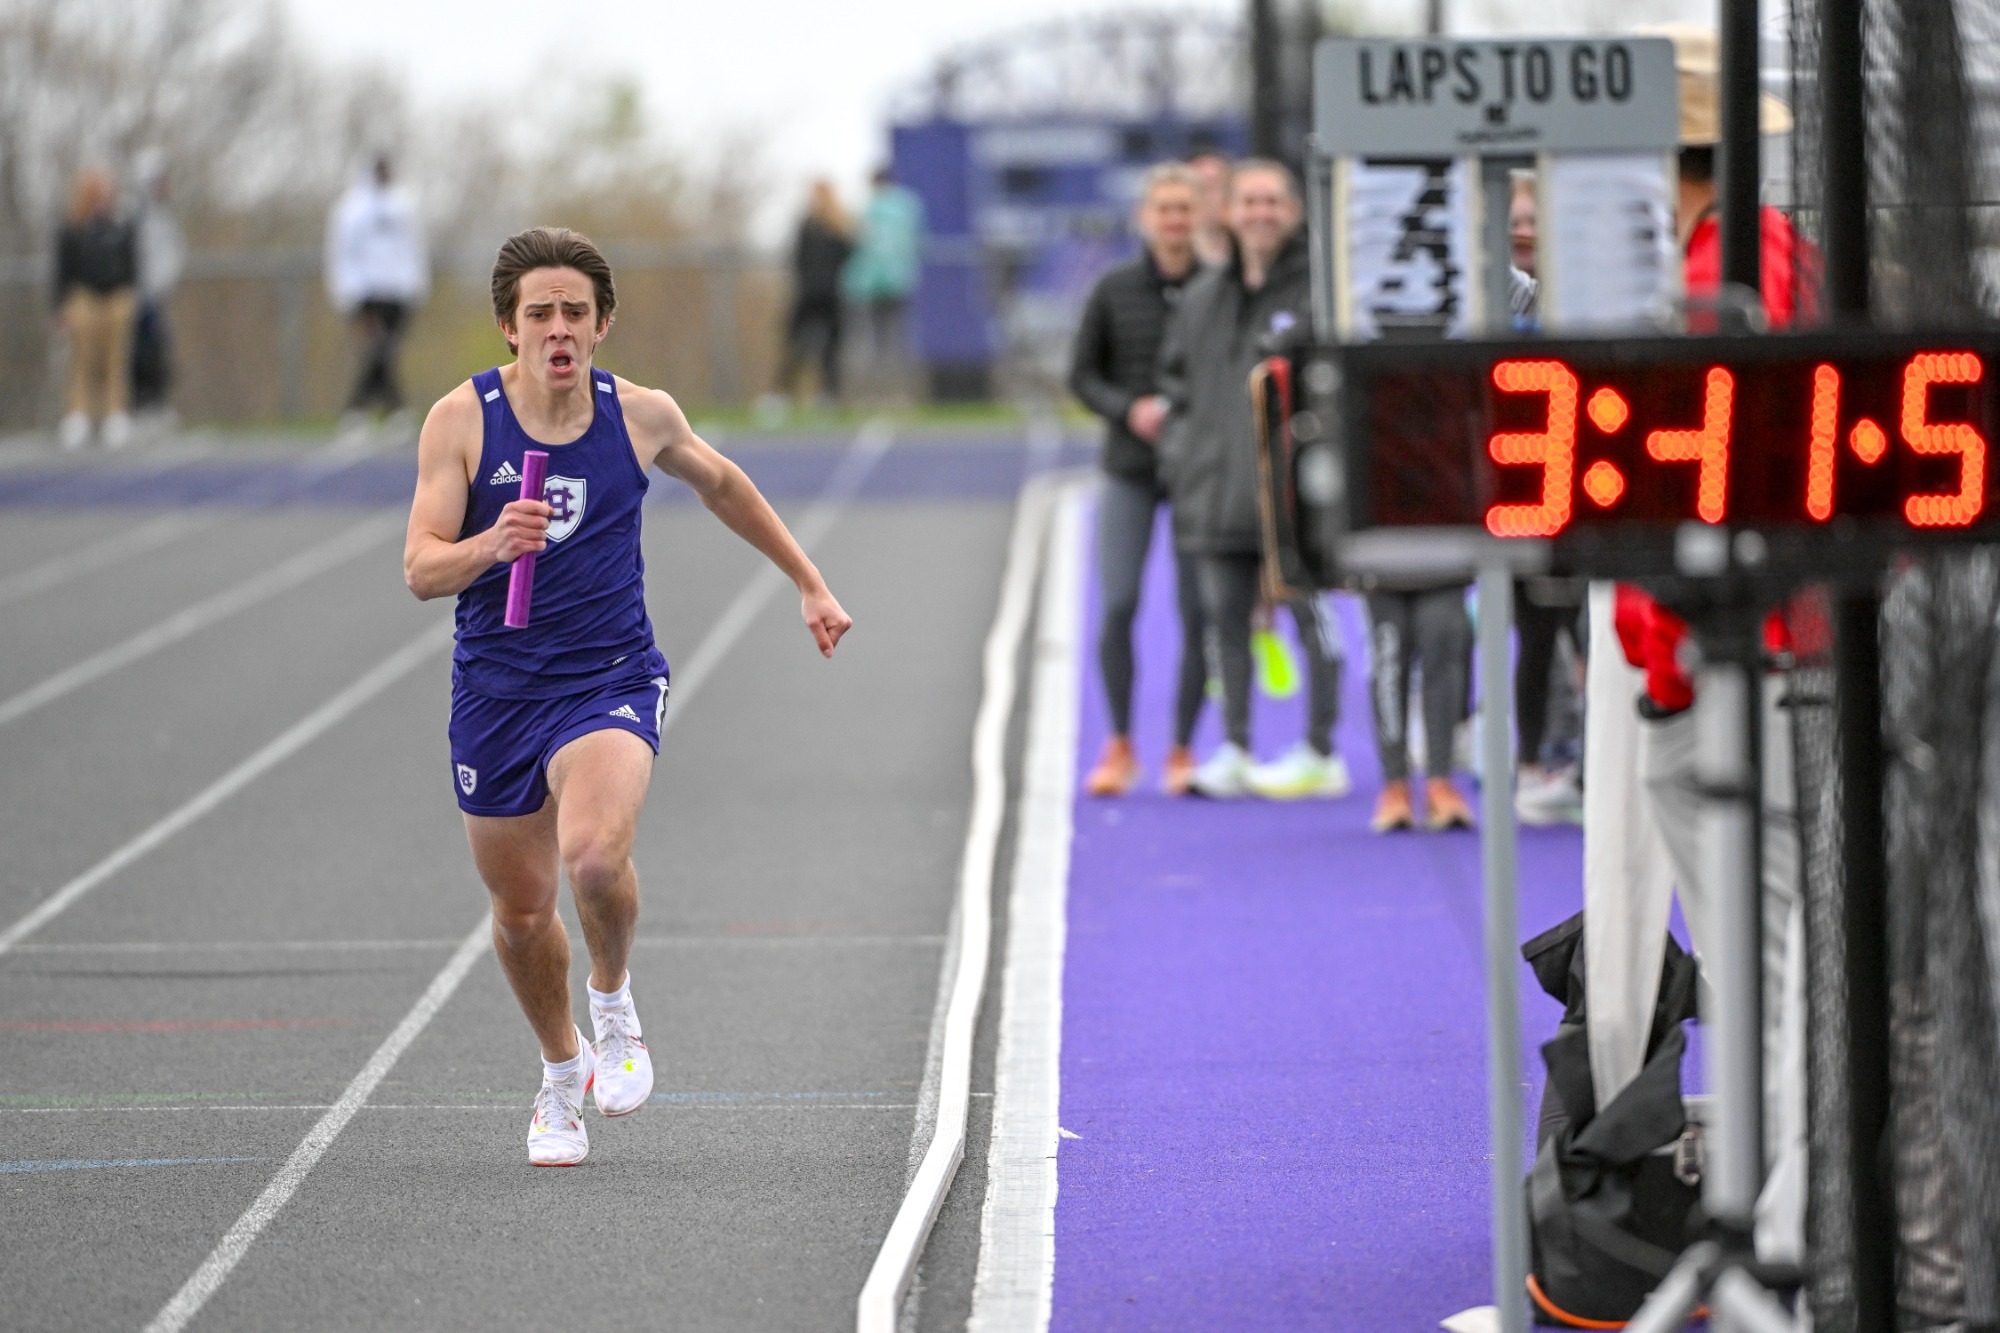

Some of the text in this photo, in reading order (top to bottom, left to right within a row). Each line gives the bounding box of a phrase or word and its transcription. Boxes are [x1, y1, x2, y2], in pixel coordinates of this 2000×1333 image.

[1358, 43, 1633, 105] LAPS TO GO
[490, 475, 523, 486] adidas
[609, 710, 641, 723] adidas
